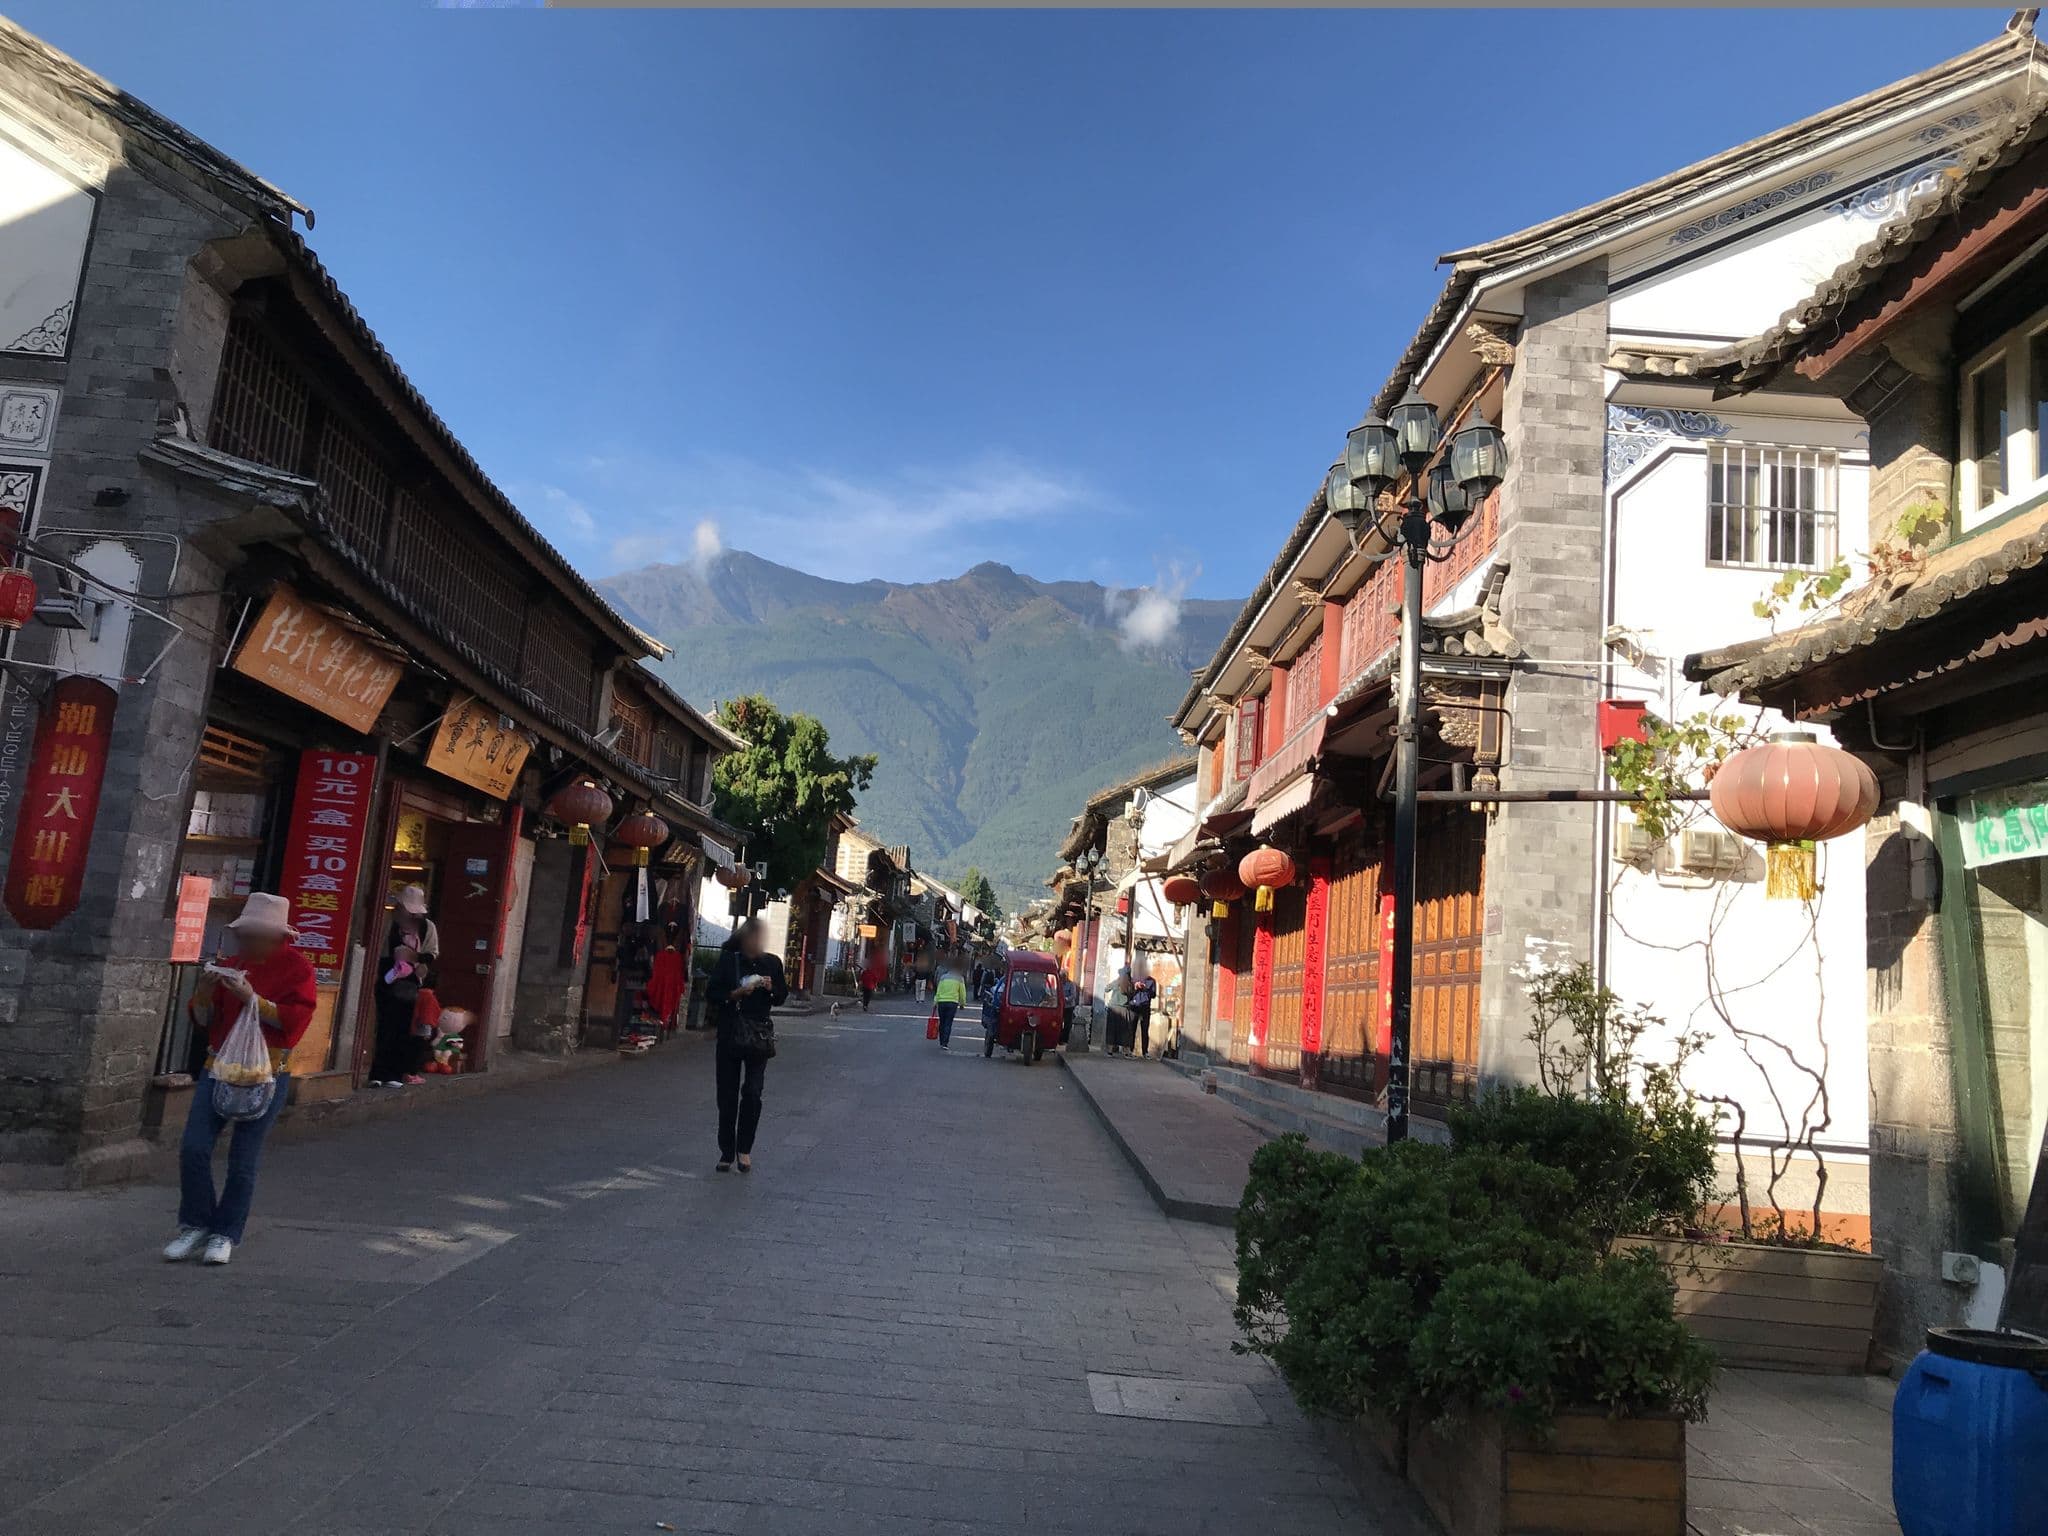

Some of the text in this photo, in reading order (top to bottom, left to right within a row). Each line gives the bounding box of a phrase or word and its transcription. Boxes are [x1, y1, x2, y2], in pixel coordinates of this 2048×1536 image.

[24, 702, 97, 906] 潮汕大排档
